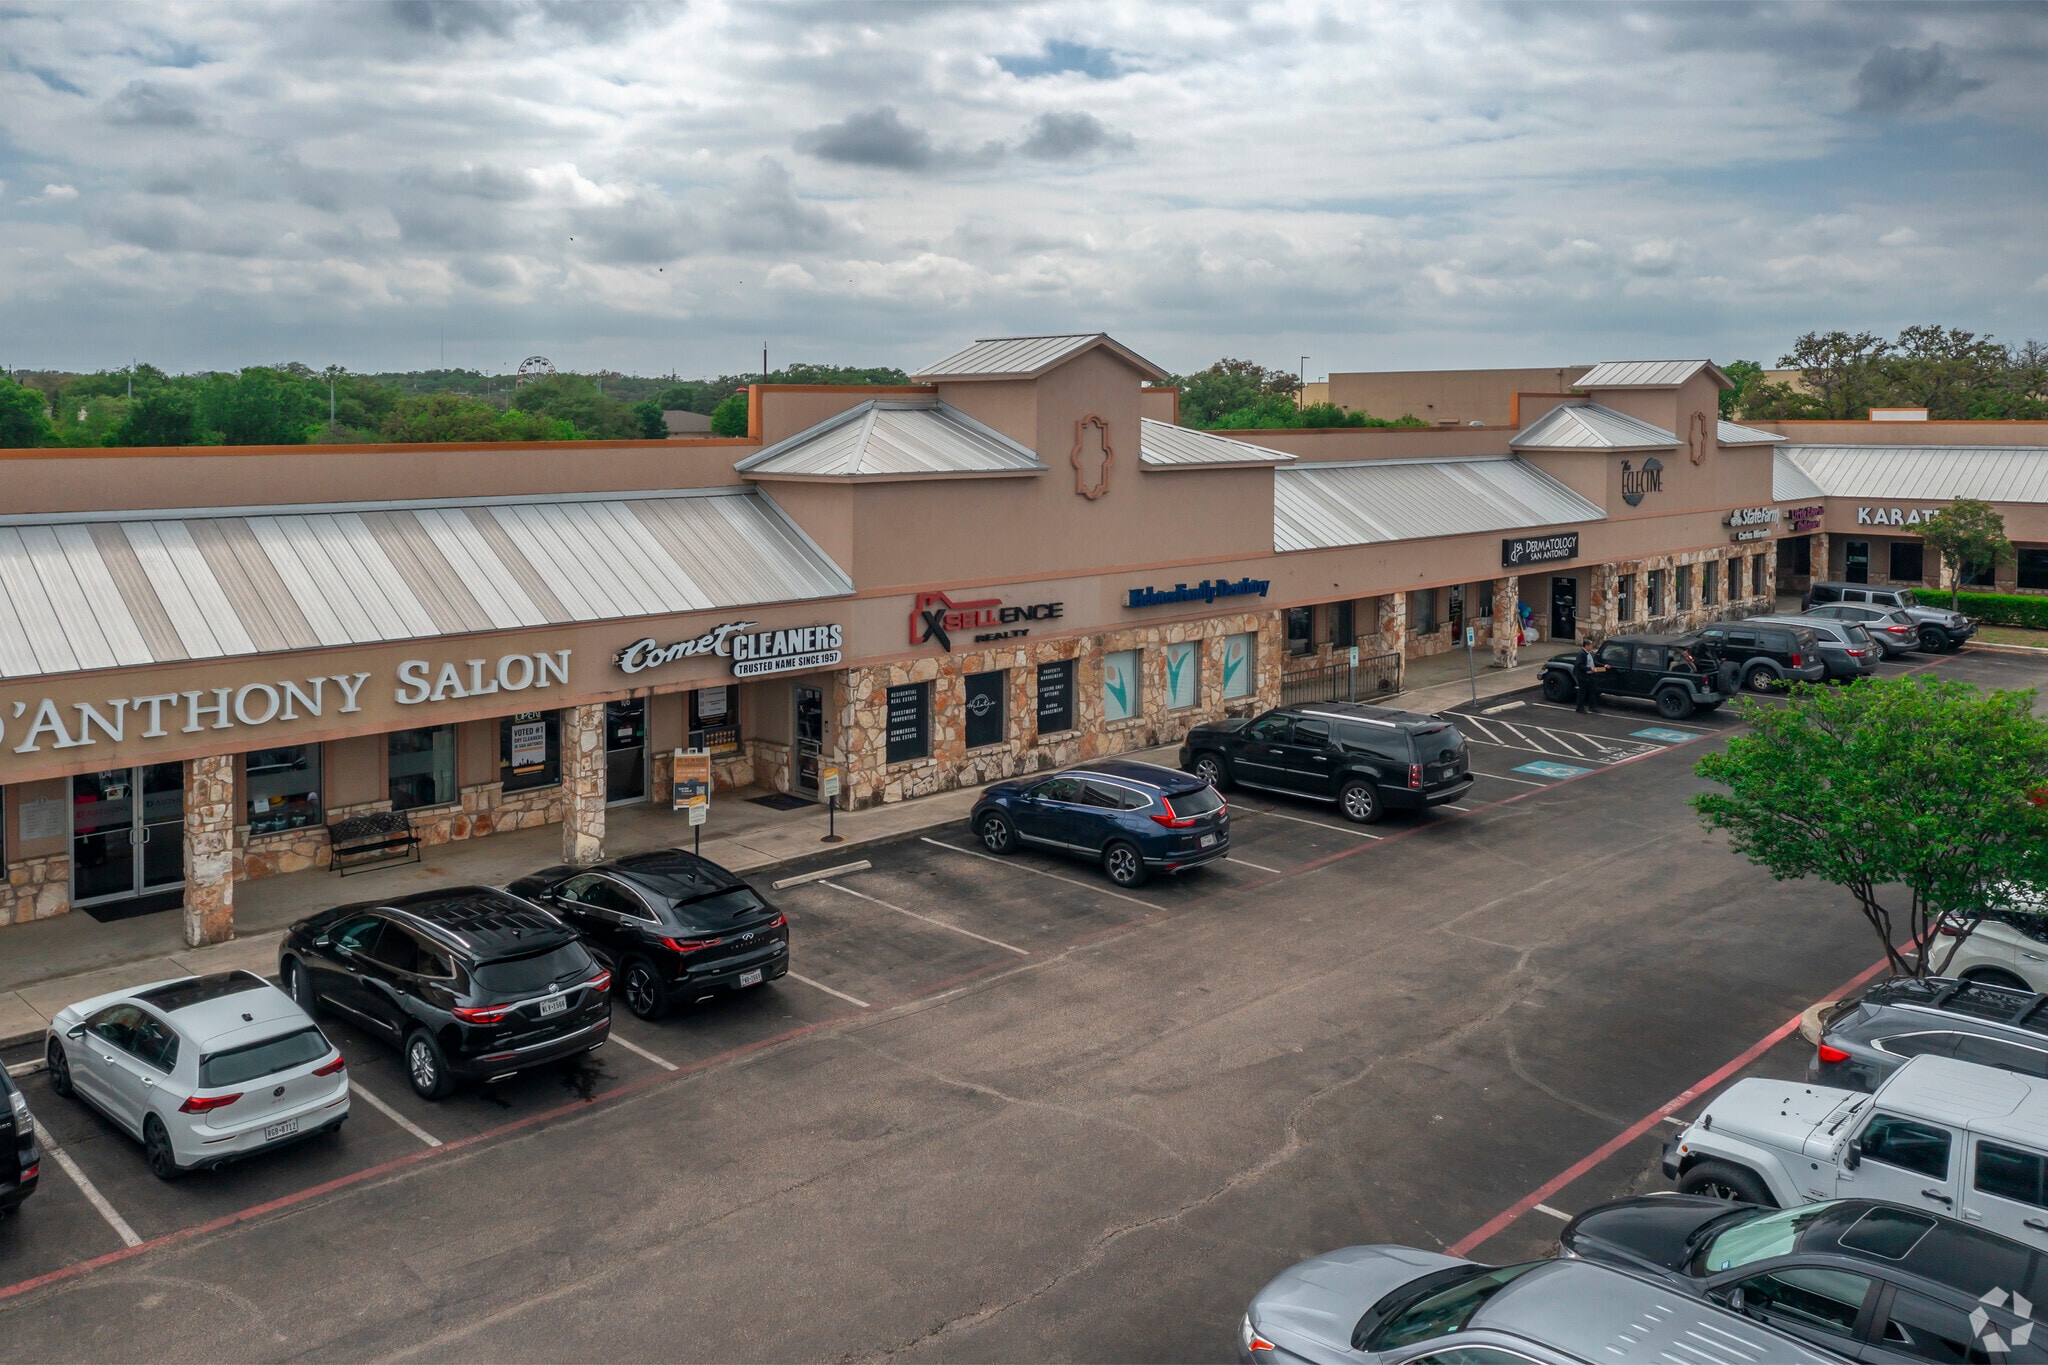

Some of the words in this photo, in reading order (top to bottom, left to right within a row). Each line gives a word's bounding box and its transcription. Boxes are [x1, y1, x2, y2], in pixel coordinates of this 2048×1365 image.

[1526, 536, 1577, 553] DERMATOLOGY
[1531, 552, 1542, 560] SAN
[1543, 549, 1569, 559] ANTONIO
[974, 629, 1030, 643] REALTY
[619, 621, 759, 674] Comet
[732, 624, 843, 661] CLEANERS
[738, 661, 773, 675] TRUSTED
[775, 658, 796, 670] NAME
[798, 656, 820, 667] SINCE
[821, 652, 838, 664] 1957
[0, 672, 371, 753] 'ANTHONY
[395, 649, 572, 704] SALON
[902, 695, 917, 703] ESTATE
[514, 727, 534, 737] VOTED
[535, 726, 544, 734] #1
[902, 732, 917, 740] ESTATE
